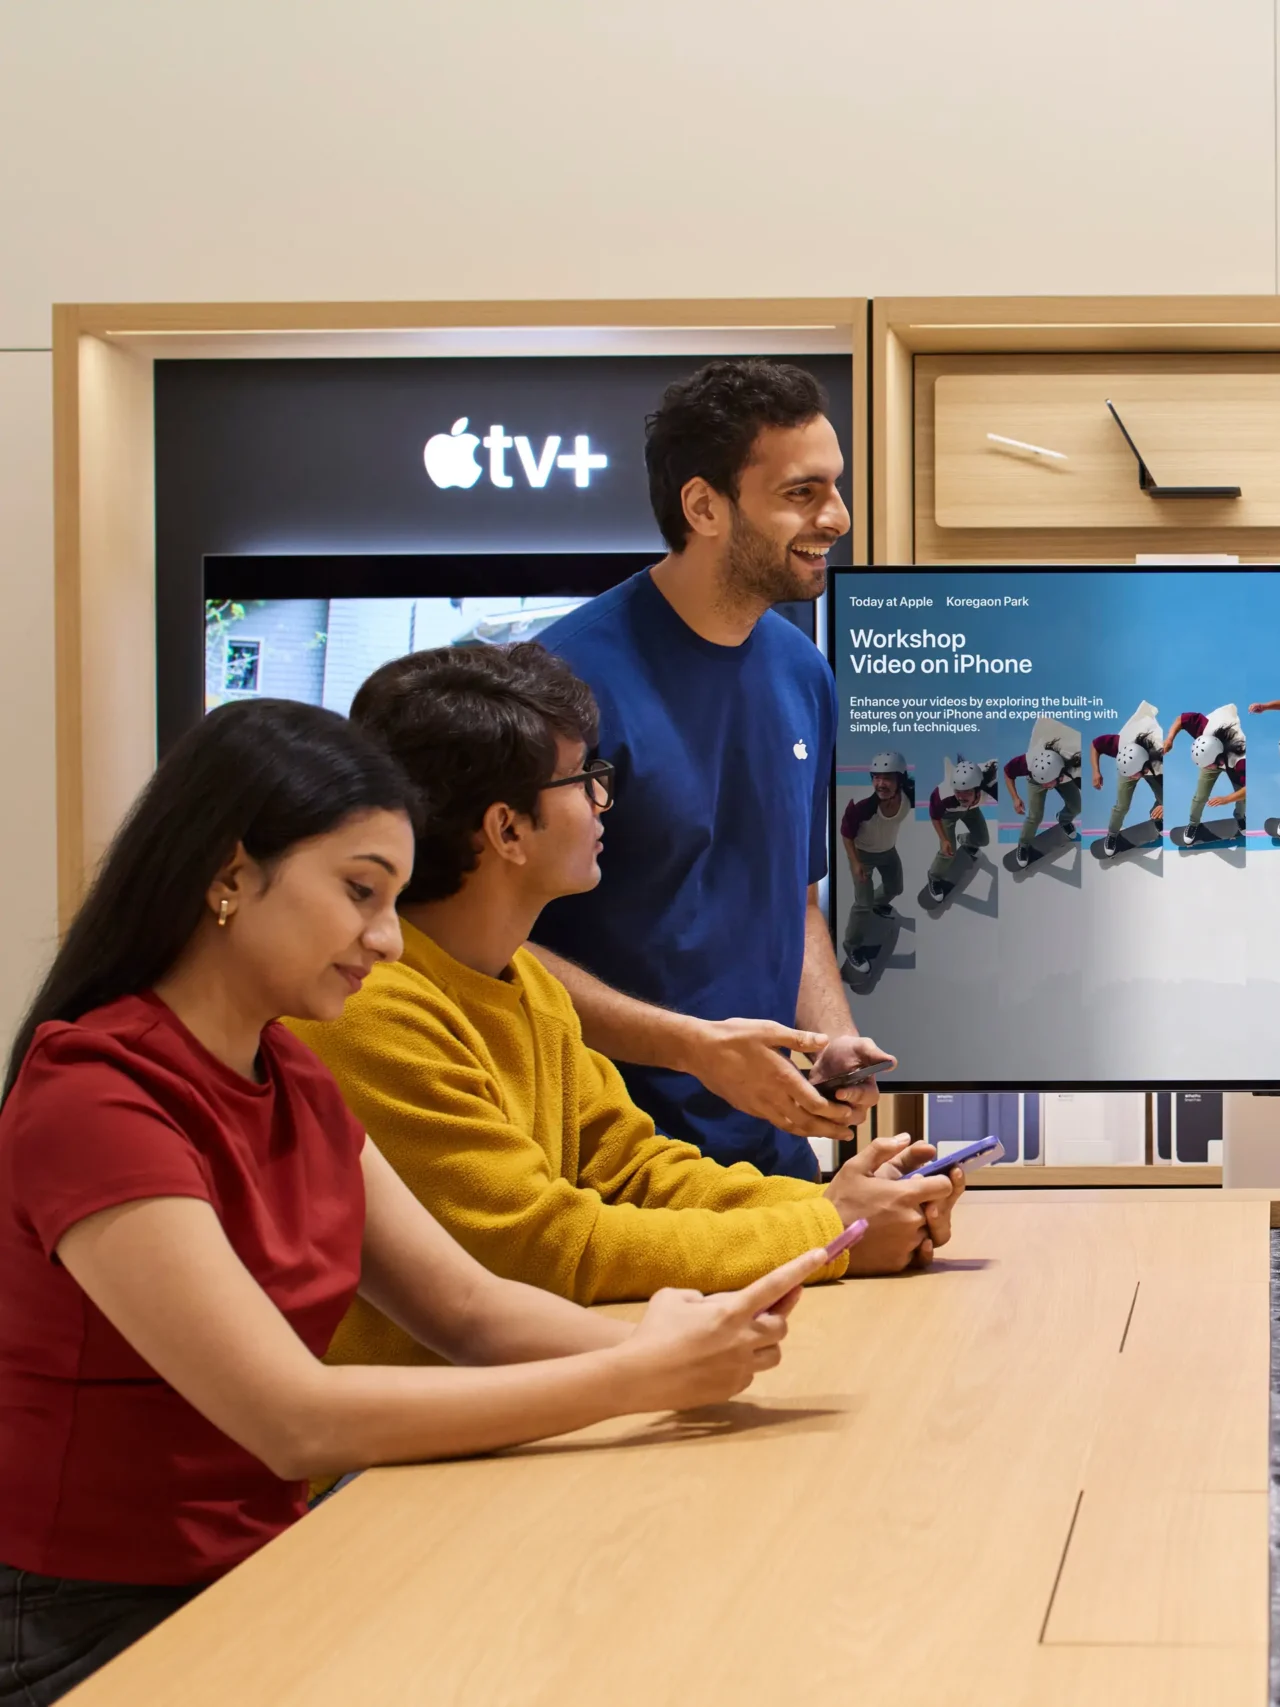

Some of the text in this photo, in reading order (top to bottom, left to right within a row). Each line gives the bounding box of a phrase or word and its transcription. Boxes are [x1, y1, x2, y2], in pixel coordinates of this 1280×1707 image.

[482, 424, 608, 489] tv+
[850, 596, 934, 609] Today at Apple
[946, 596, 1030, 609] Koregaon Park
[850, 628, 966, 653] Workshop
[850, 654, 1034, 675] Video on iPhone
[850, 696, 1104, 710] Enhance your videos by exploring the built-in
[849, 708, 1118, 723] features on your iPhone and experimenting with
[849, 721, 981, 735] simple, fun techniques.
